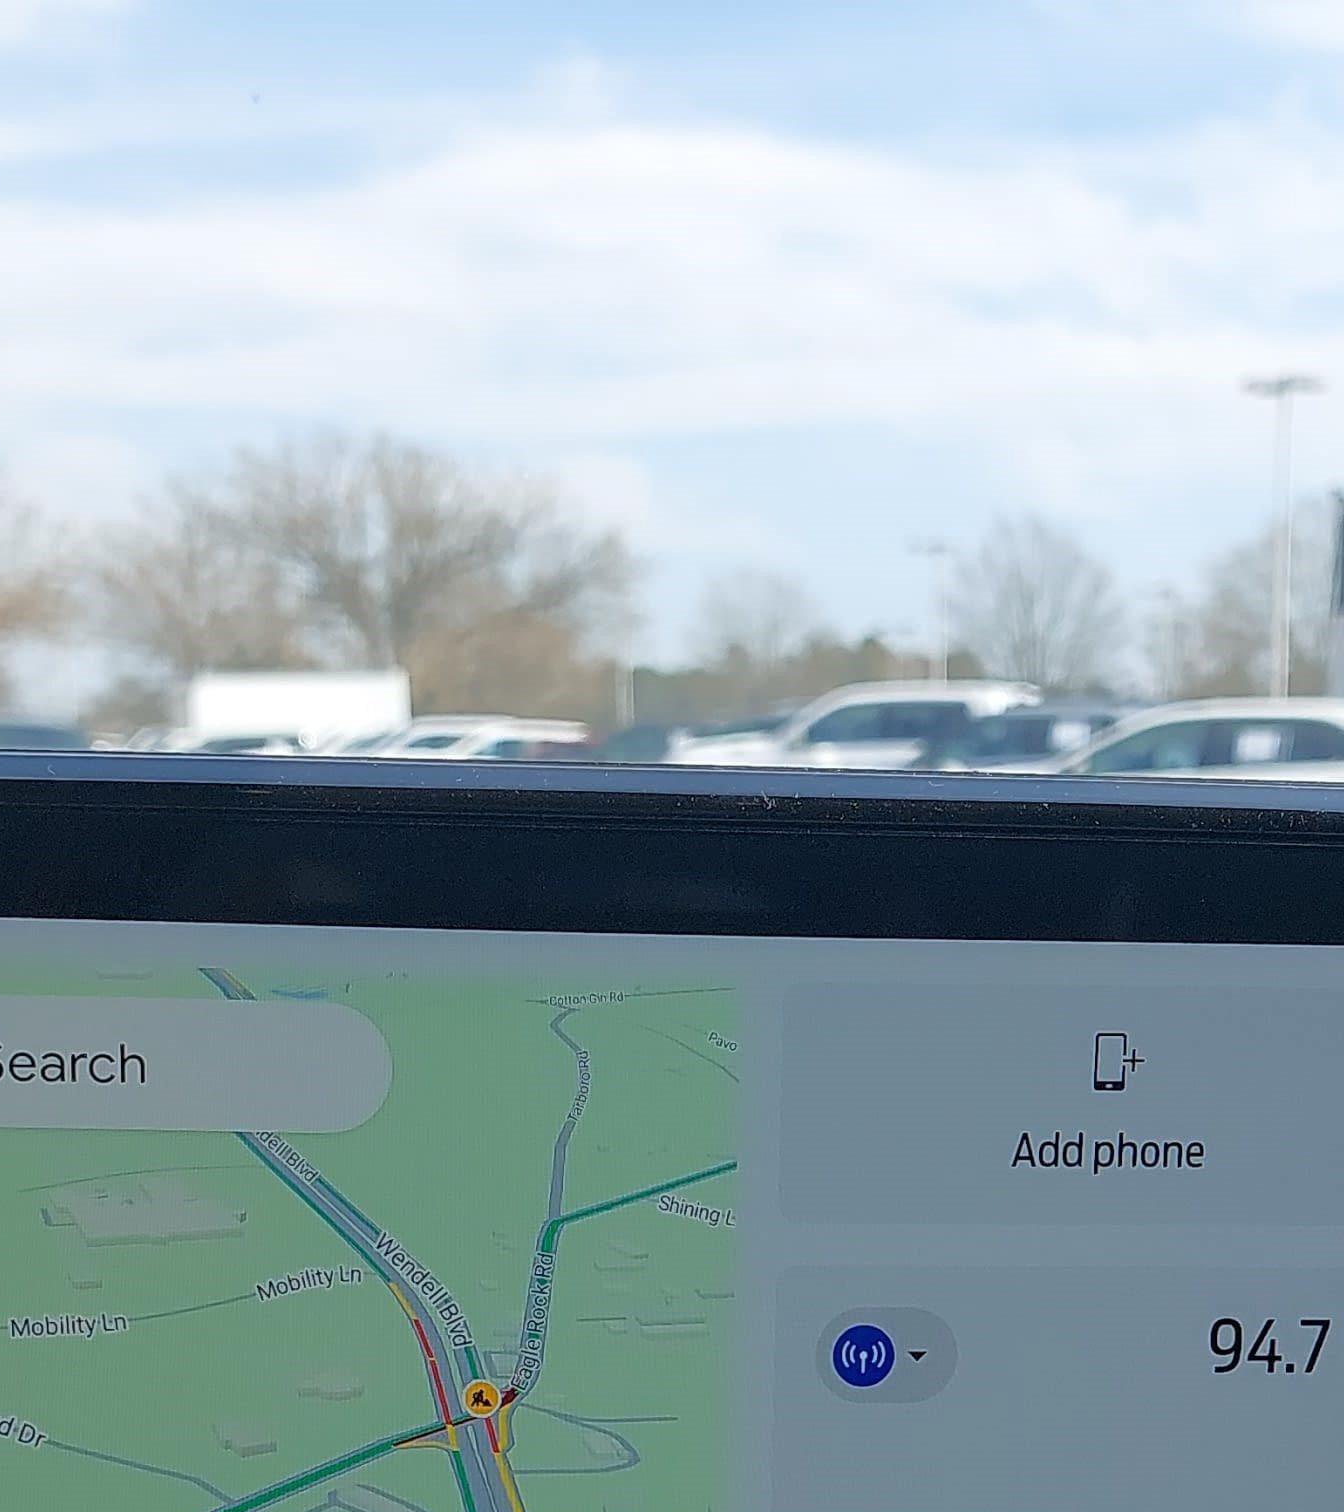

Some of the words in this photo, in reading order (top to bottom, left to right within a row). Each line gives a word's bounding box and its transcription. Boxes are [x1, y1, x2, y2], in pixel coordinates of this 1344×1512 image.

[609, 991, 624, 1003] Rd
[708, 1031, 738, 1052] Pavo
[566, 1071, 591, 1122] Tarboro
[256, 1130, 289, 1158] dell
[285, 1151, 319, 1183] Blvd
[1011, 1131, 1084, 1169] Add
[1092, 1132, 1206, 1176] phone
[658, 1194, 721, 1227] Shining
[256, 1268, 334, 1302] Mobility
[339, 1265, 362, 1283] Ln
[534, 1252, 554, 1281] Rd
[375, 1230, 449, 1305] Wendell
[439, 1302, 473, 1347] Blvd
[527, 1283, 549, 1333] Rock
[10, 1315, 96, 1338] Mobility
[101, 1313, 127, 1332] Ln
[1208, 1316, 1332, 1374] 94.7
[511, 1337, 542, 1391] Eagle
[17, 1422, 47, 1448] Dr
